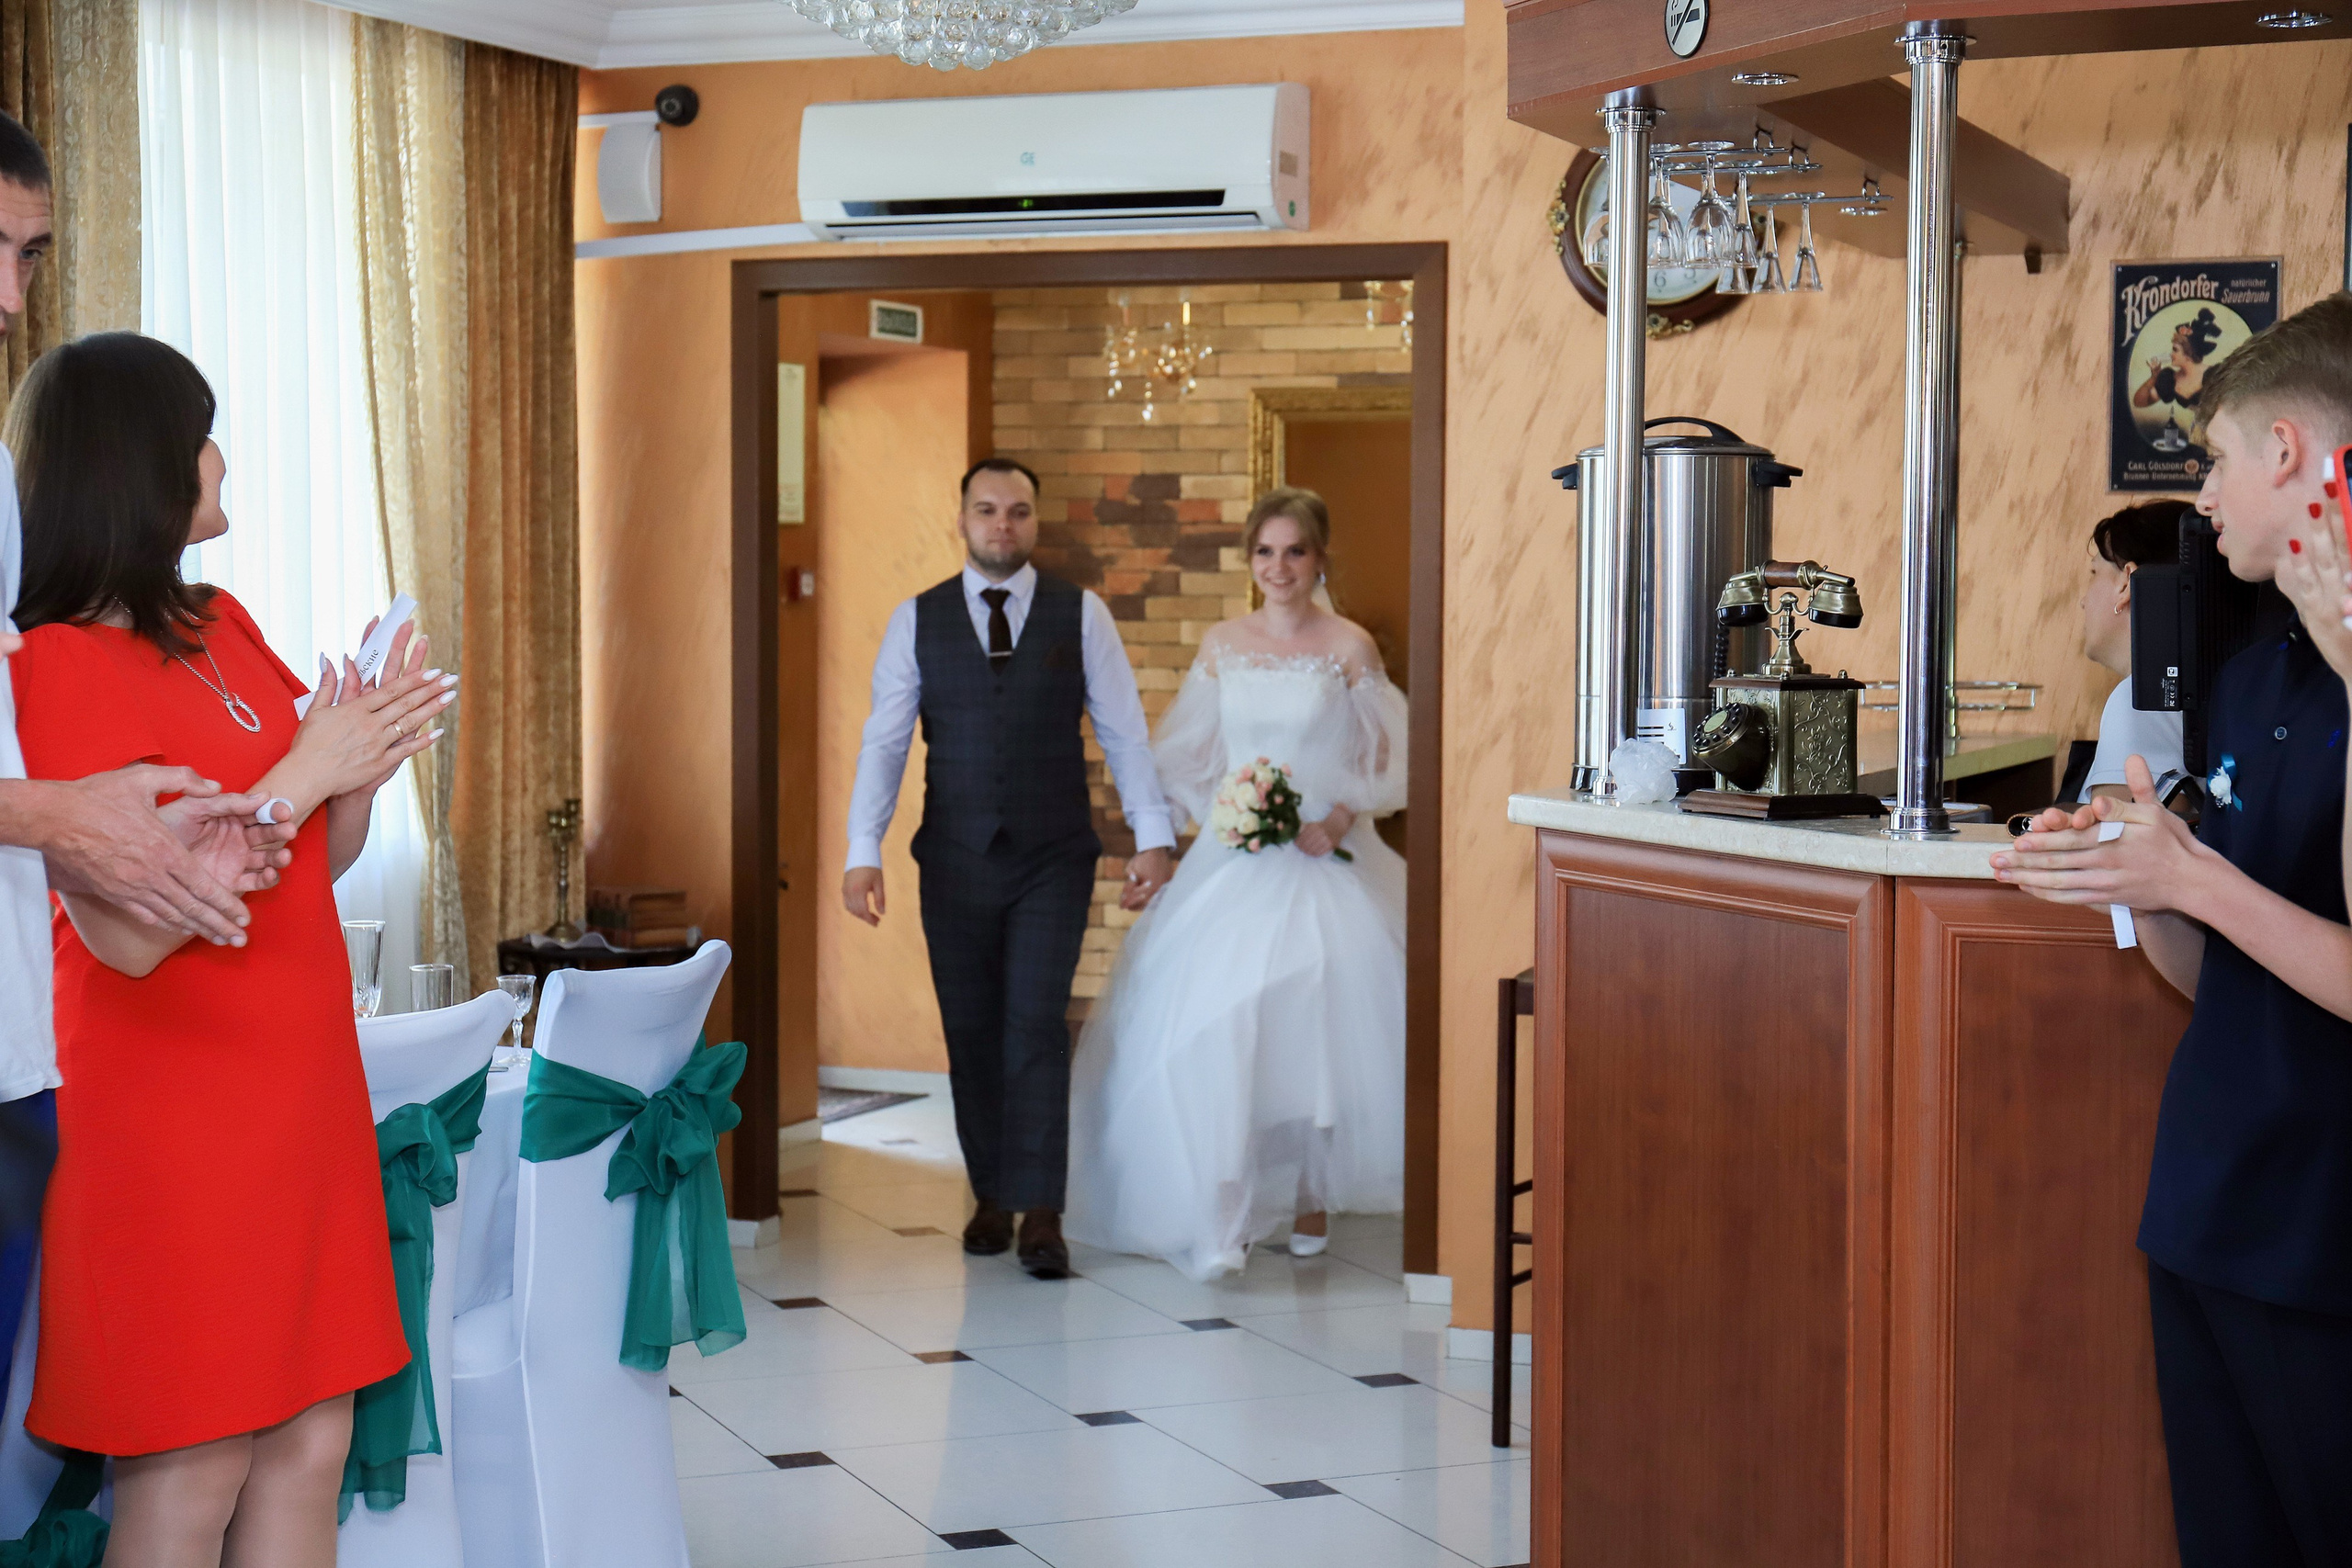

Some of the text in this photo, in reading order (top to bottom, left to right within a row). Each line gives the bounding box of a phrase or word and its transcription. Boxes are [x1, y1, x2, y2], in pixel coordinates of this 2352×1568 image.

[1655, 270, 1667, 288] 6
[2221, 288, 2270, 303] Sauerbrunn
[2121, 273, 2220, 347] Krondorfer
